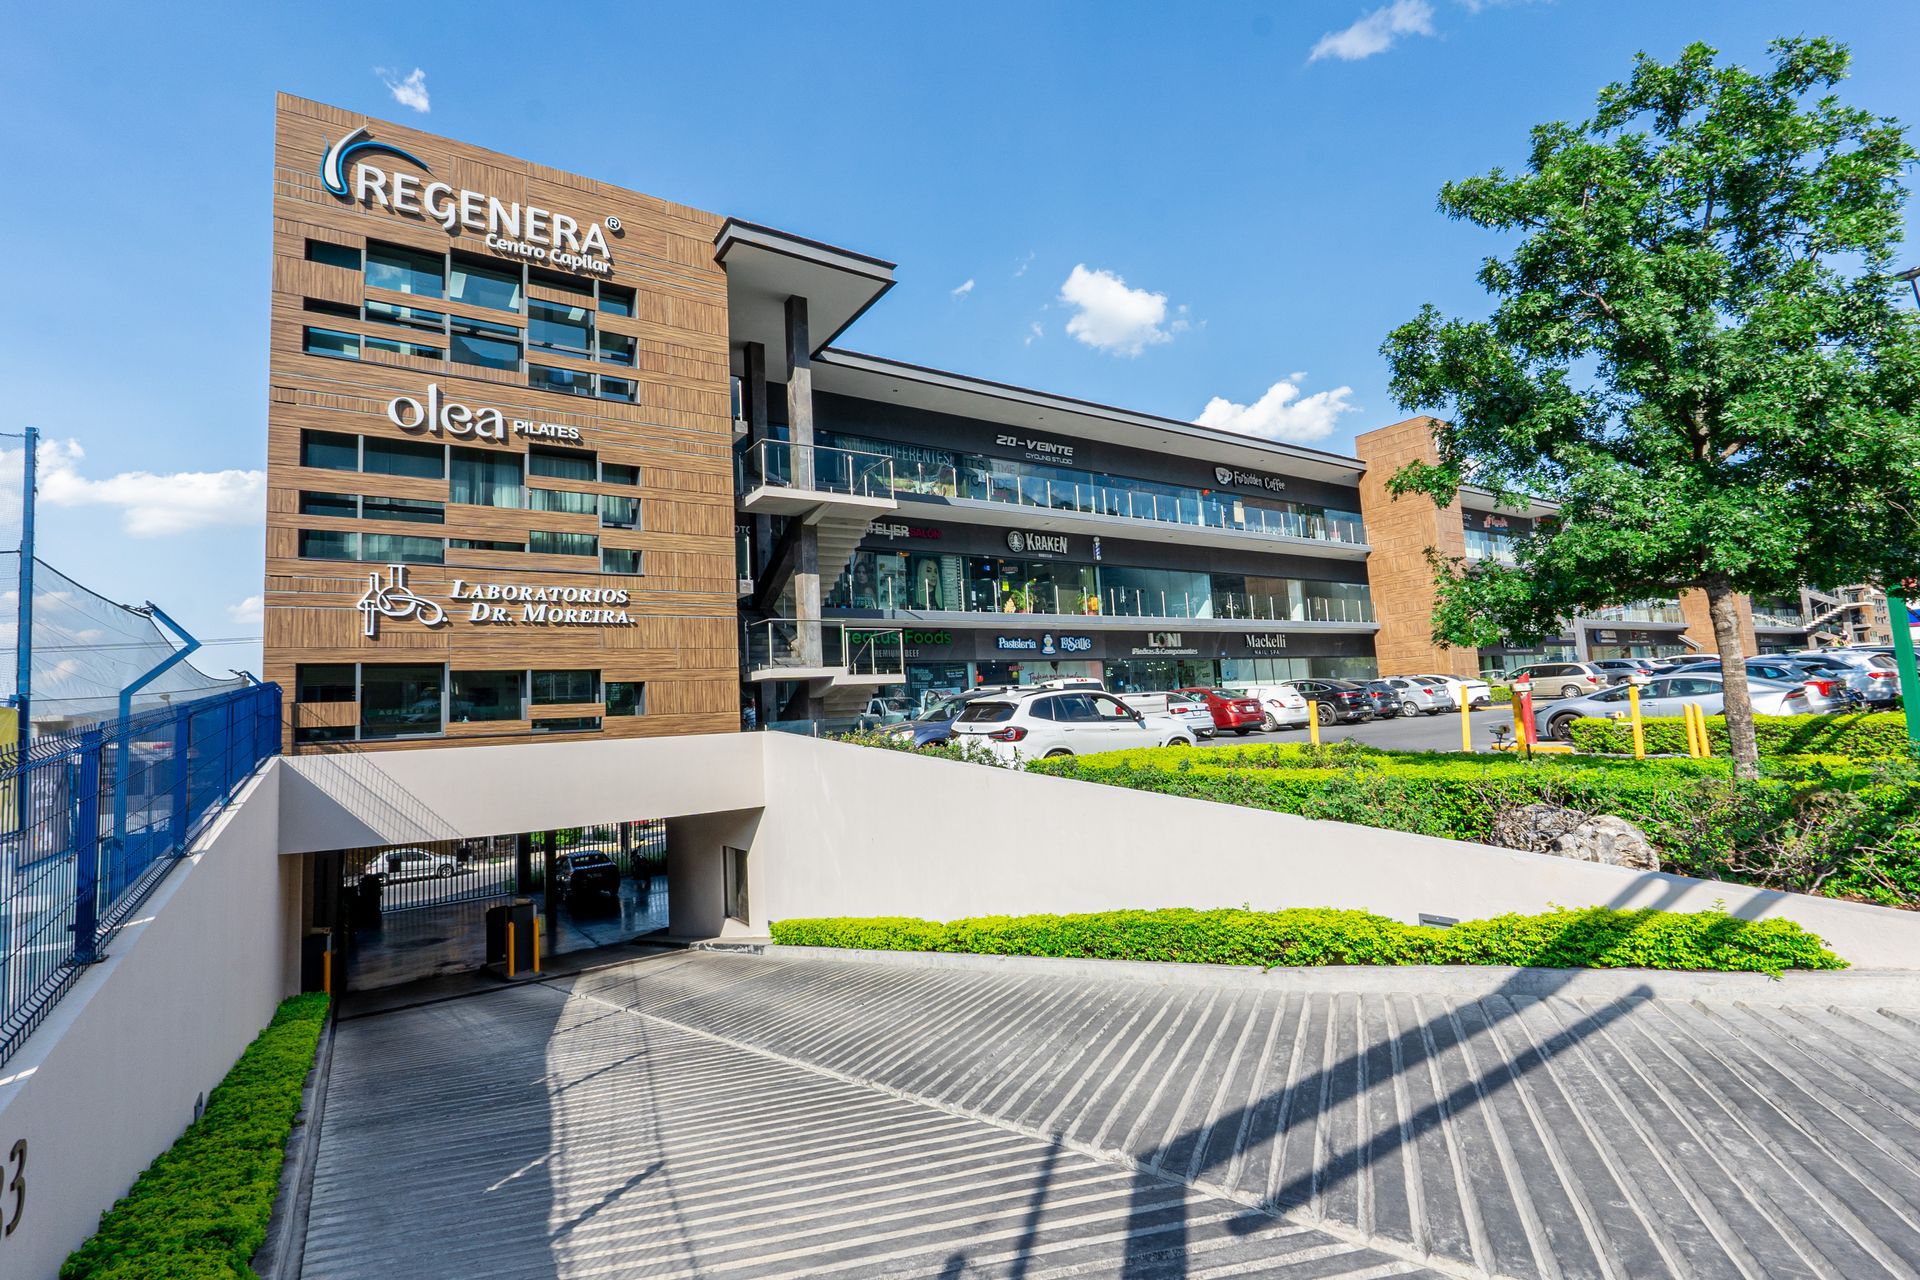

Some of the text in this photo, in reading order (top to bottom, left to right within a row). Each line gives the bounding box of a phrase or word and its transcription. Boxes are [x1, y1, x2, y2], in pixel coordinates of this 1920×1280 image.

[485, 233, 611, 273] Centro Capilar
[387, 383, 504, 439] olea
[513, 420, 579, 440] PILATES
[1234, 471, 1286, 492] Forbidden Coffee
[1025, 533, 1068, 554] KRAKEN
[450, 579, 628, 604] LABORATORIOS
[469, 603, 513, 623] DR.
[904, 629, 952, 645] Foods
[1245, 633, 1287, 648] Mackelli
